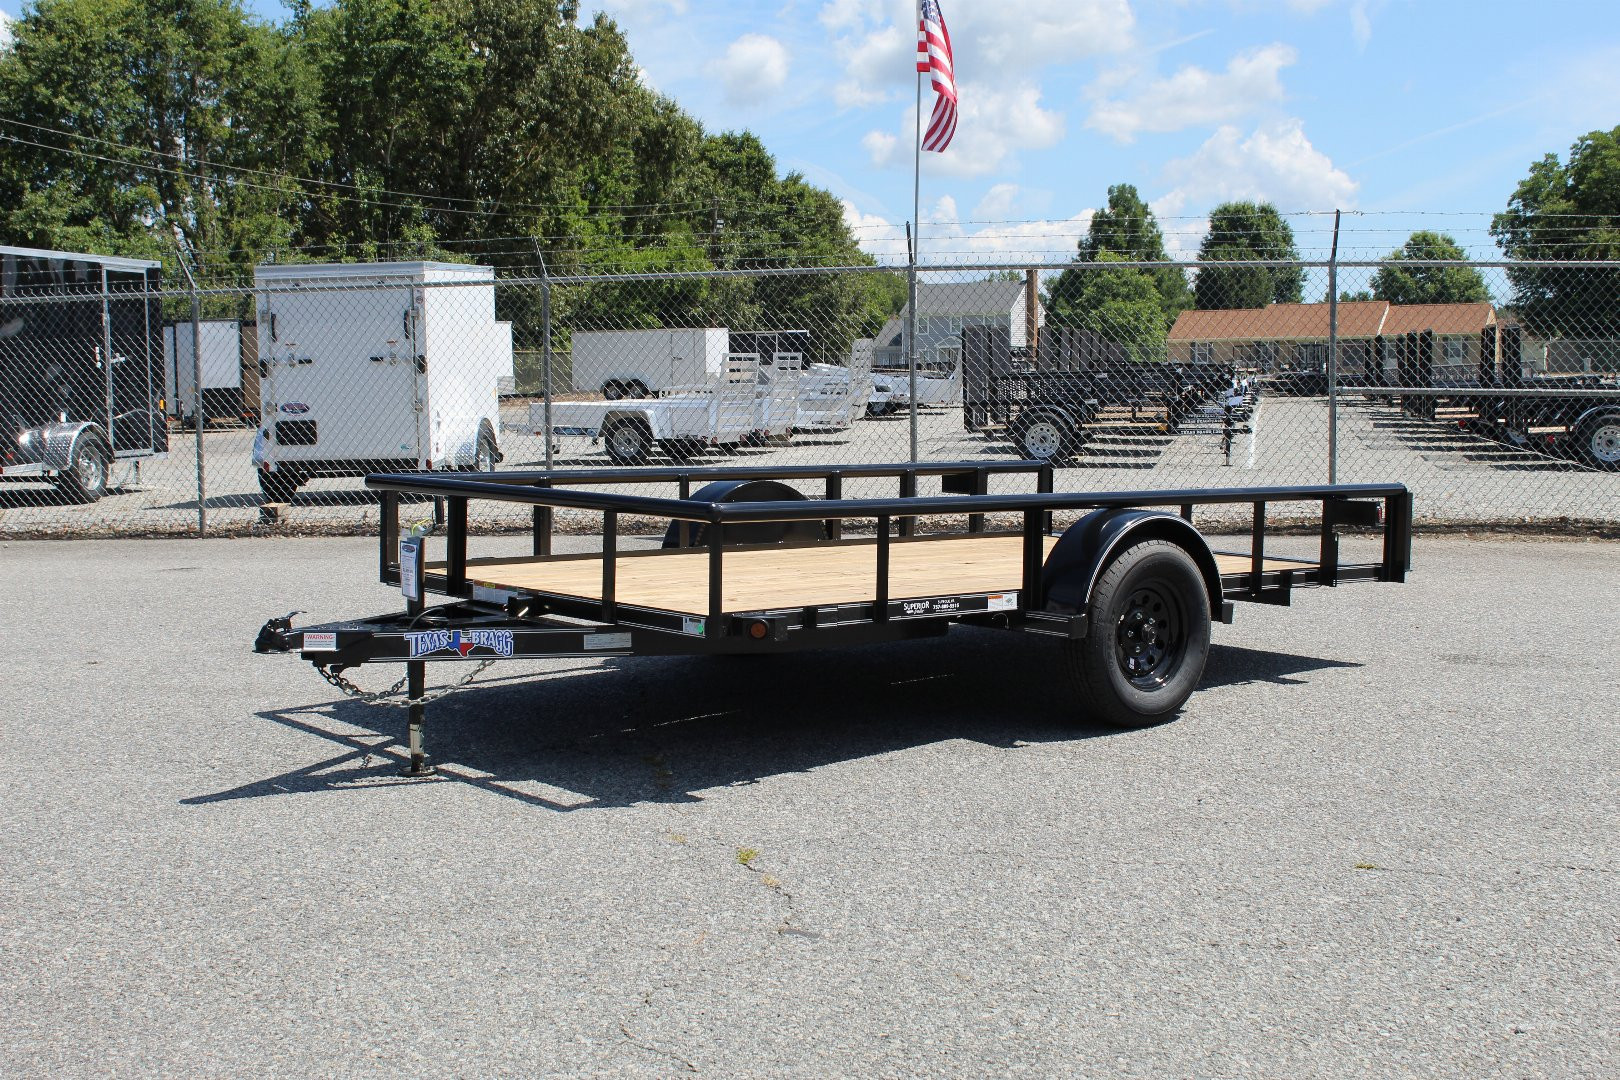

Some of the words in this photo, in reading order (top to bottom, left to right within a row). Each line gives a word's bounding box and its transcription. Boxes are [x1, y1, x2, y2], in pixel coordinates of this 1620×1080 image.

[903, 600, 930, 611] SUPERIOR
[404, 631, 449, 658] TEXAS
[470, 630, 513, 657] BRAGG
